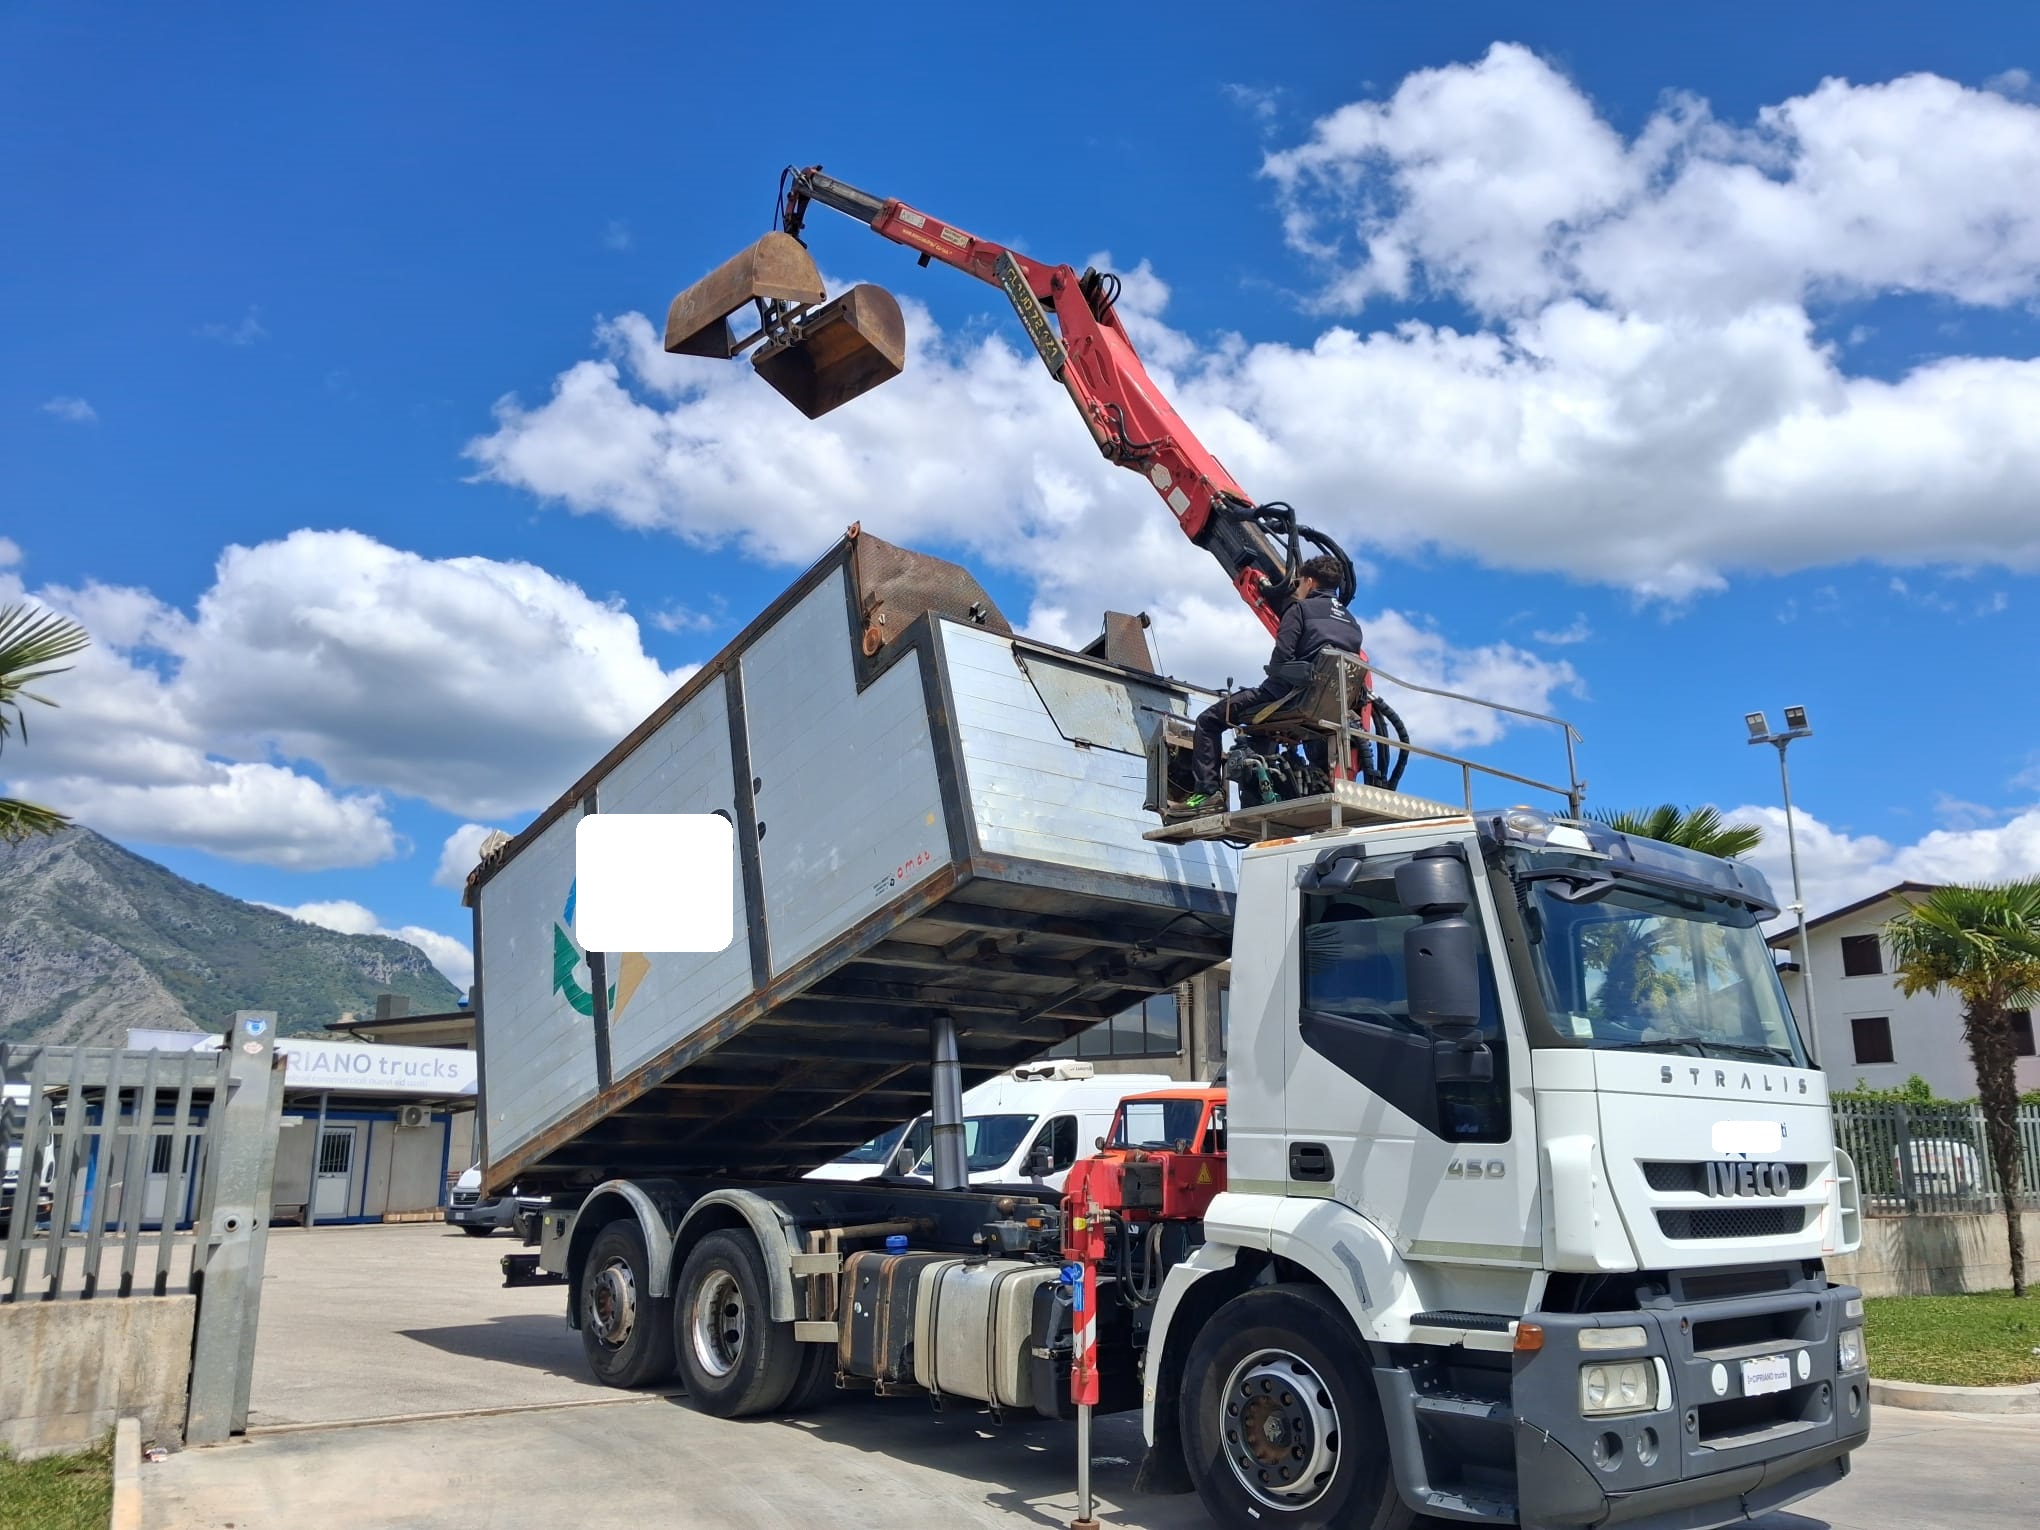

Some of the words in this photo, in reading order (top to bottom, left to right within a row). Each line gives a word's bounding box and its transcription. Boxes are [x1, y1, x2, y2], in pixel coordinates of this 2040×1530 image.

[286, 1051, 372, 1074] RIANO
[378, 1056, 458, 1078] trucks
[1660, 1065, 1807, 1095] STRALIS
[1447, 1158, 1506, 1177] 450
[1706, 1161, 1790, 1198] IVECO
